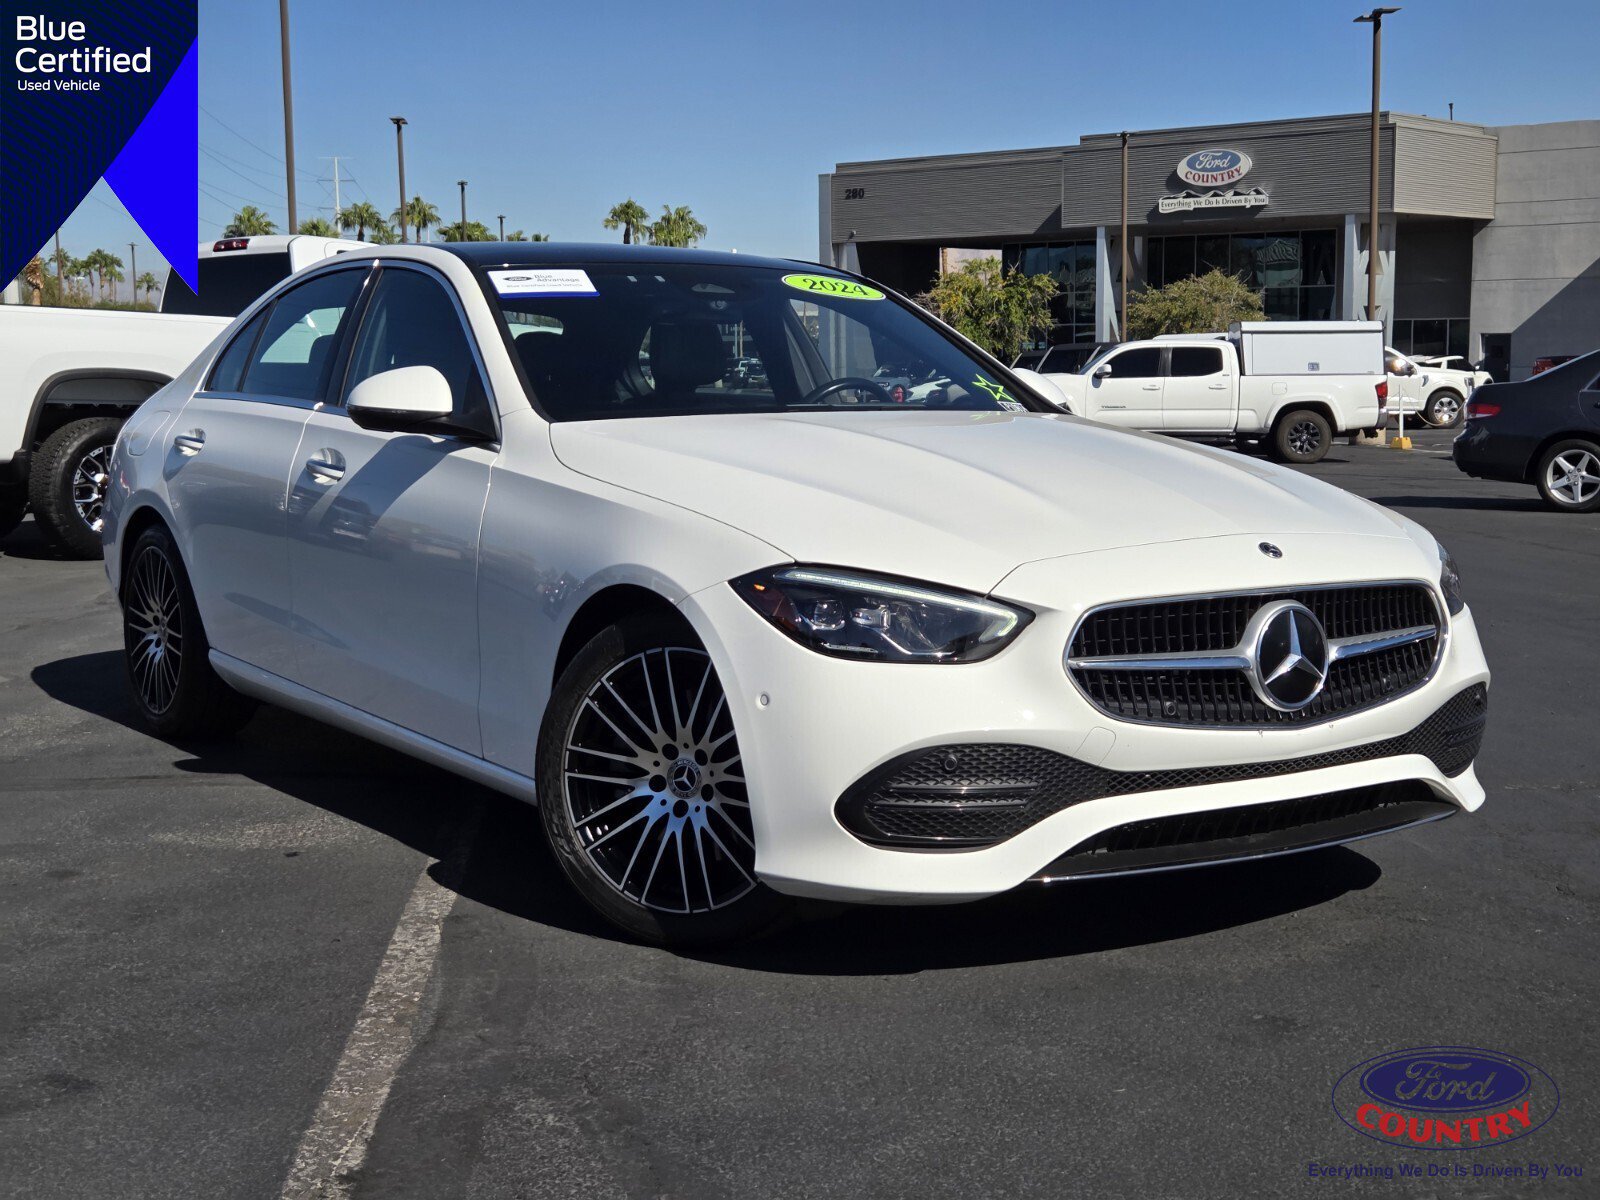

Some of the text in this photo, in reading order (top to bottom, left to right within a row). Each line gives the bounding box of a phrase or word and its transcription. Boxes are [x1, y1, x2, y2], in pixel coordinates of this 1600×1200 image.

[1195, 151, 1231, 169] Ford
[1185, 166, 1243, 183] COUNTRY
[1161, 199, 1192, 209] Everything
[1222, 197, 1243, 205] Driven
[1244, 197, 1252, 205] By
[803, 278, 868, 296] 2024
